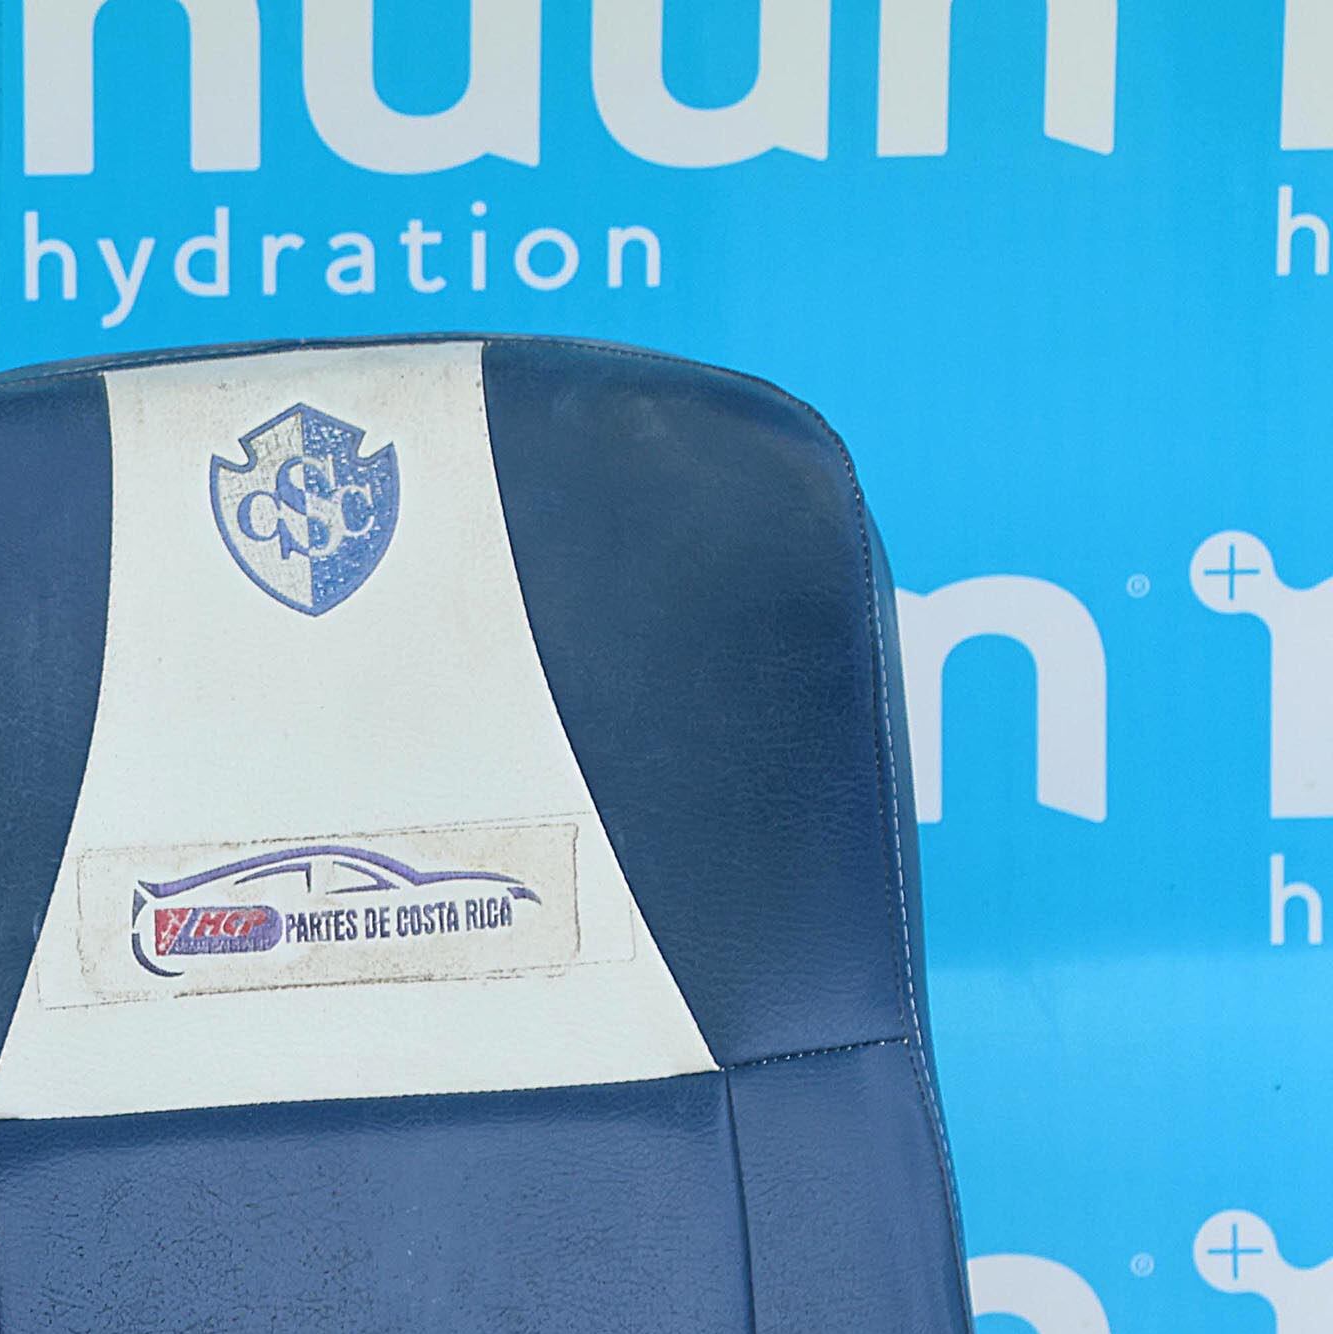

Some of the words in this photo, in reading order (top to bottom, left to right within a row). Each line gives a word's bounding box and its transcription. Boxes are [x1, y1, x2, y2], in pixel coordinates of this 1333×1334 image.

[23, 201, 662, 328] hydration
[285, 912, 359, 943] PARTES
[365, 909, 391, 940] DE
[396, 902, 460, 937] COSTA
[465, 896, 513, 932] RICA
